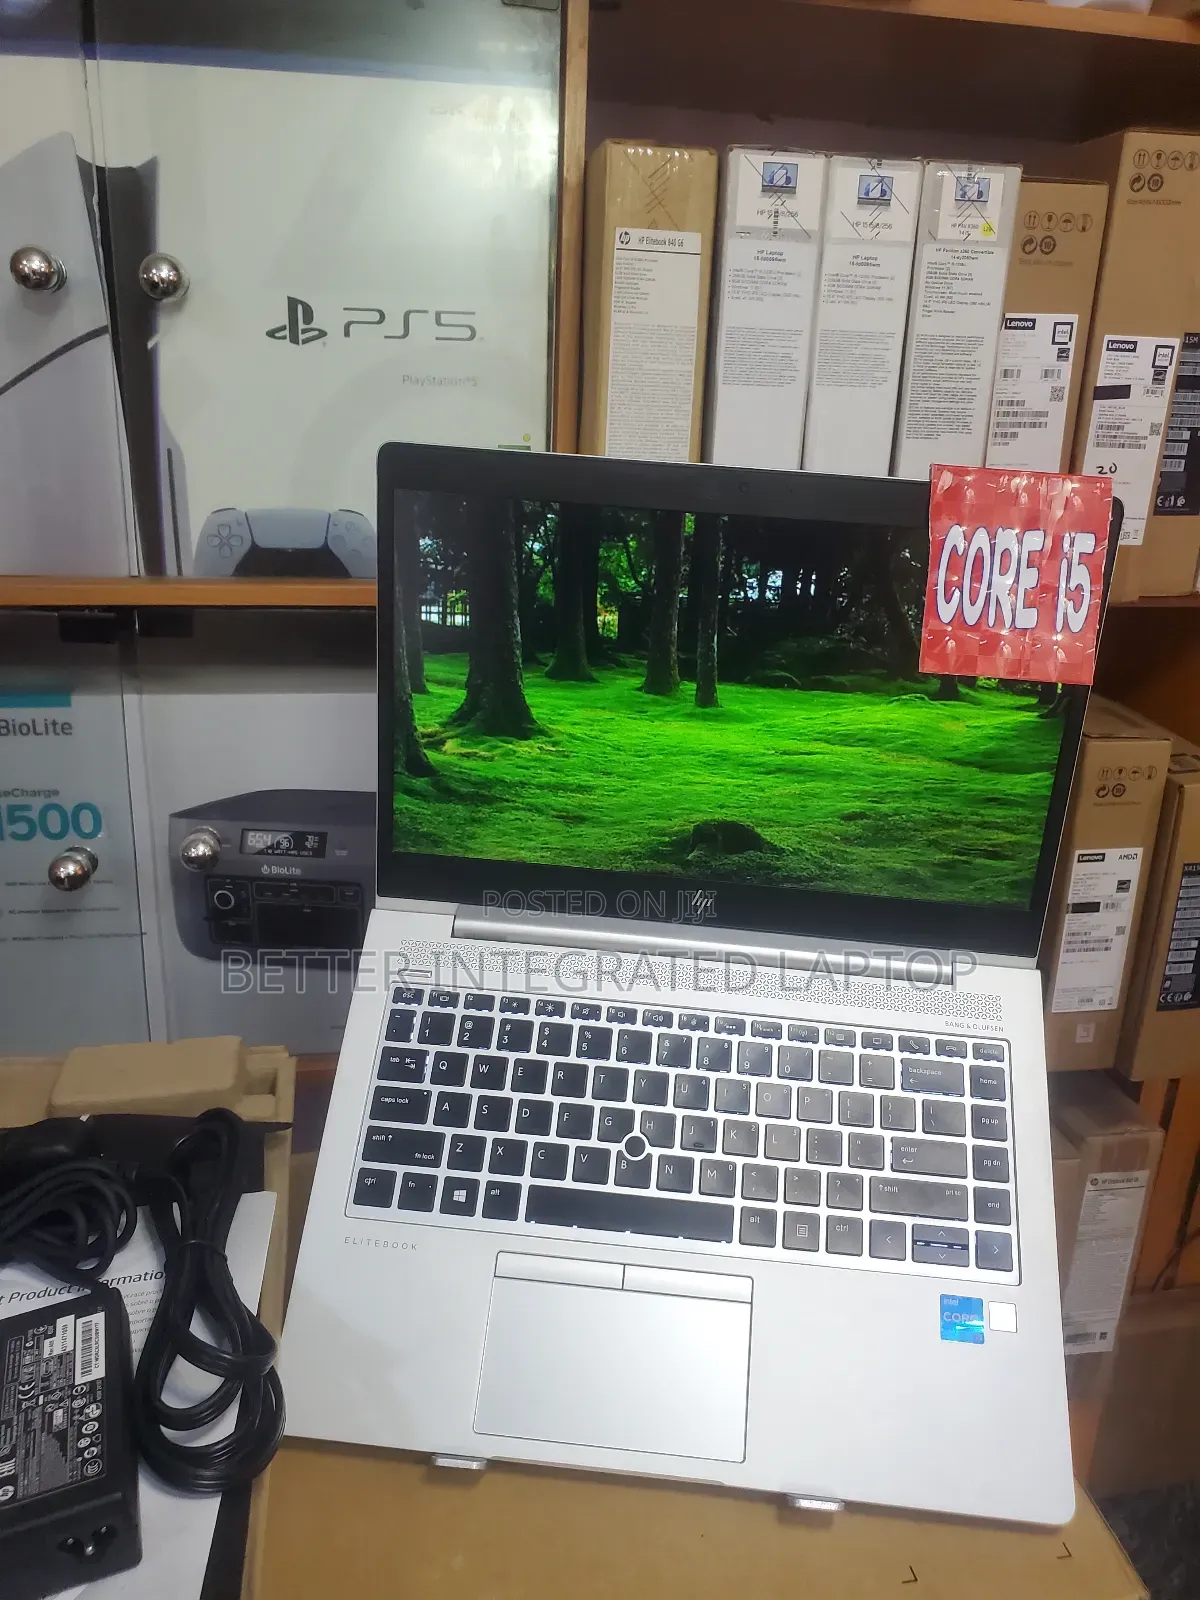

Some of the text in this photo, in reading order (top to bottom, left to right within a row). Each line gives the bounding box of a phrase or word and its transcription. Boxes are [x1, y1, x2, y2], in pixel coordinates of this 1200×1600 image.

[343, 306, 478, 342] PS5
[1007, 319, 1034, 328] Lenovo
[1108, 341, 1135, 350] Lenovo
[936, 523, 1096, 633] CORE i5
[271, 865, 302, 876] BioLite
[463, 1032, 470, 1041] 2
[502, 1035, 509, 1044] 3
[541, 1039, 548, 1048] 4
[581, 1042, 588, 1051] 5
[621, 1046, 628, 1055] 6
[439, 1060, 448, 1070] Q
[703, 1056, 709, 1065] 8
[743, 1061, 750, 1070] 9
[479, 1063, 489, 1074] W
[517, 1067, 524, 1076] E
[908, 1066, 942, 1076] backspace
[557, 1070, 564, 1080] R
[600, 1074, 606, 1084] T
[640, 1078, 647, 1088] Y
[979, 1077, 997, 1085] home
[681, 1083, 688, 1093] U
[804, 1096, 811, 1106] P
[442, 1102, 450, 1111] A
[481, 1105, 489, 1114] S
[522, 1108, 530, 1118] D
[563, 1112, 570, 1122] F
[604, 1116, 613, 1126] G
[646, 1120, 654, 1130] H
[730, 1129, 738, 1139] K
[456, 1142, 464, 1153] Z
[496, 1146, 505, 1155] X
[537, 1150, 546, 1159] C
[580, 1153, 588, 1163] V
[620, 1160, 628, 1169] B
[665, 1164, 674, 1174] N
[707, 1169, 717, 1179] M
[884, 1185, 899, 1193] shift
[987, 1201, 1000, 1209] end
[749, 1215, 761, 1224] alt
[835, 1224, 849, 1232] ctrl
[344, 1236, 418, 1251] ELITEBOOK
[8, 1284, 73, 1304] Product
